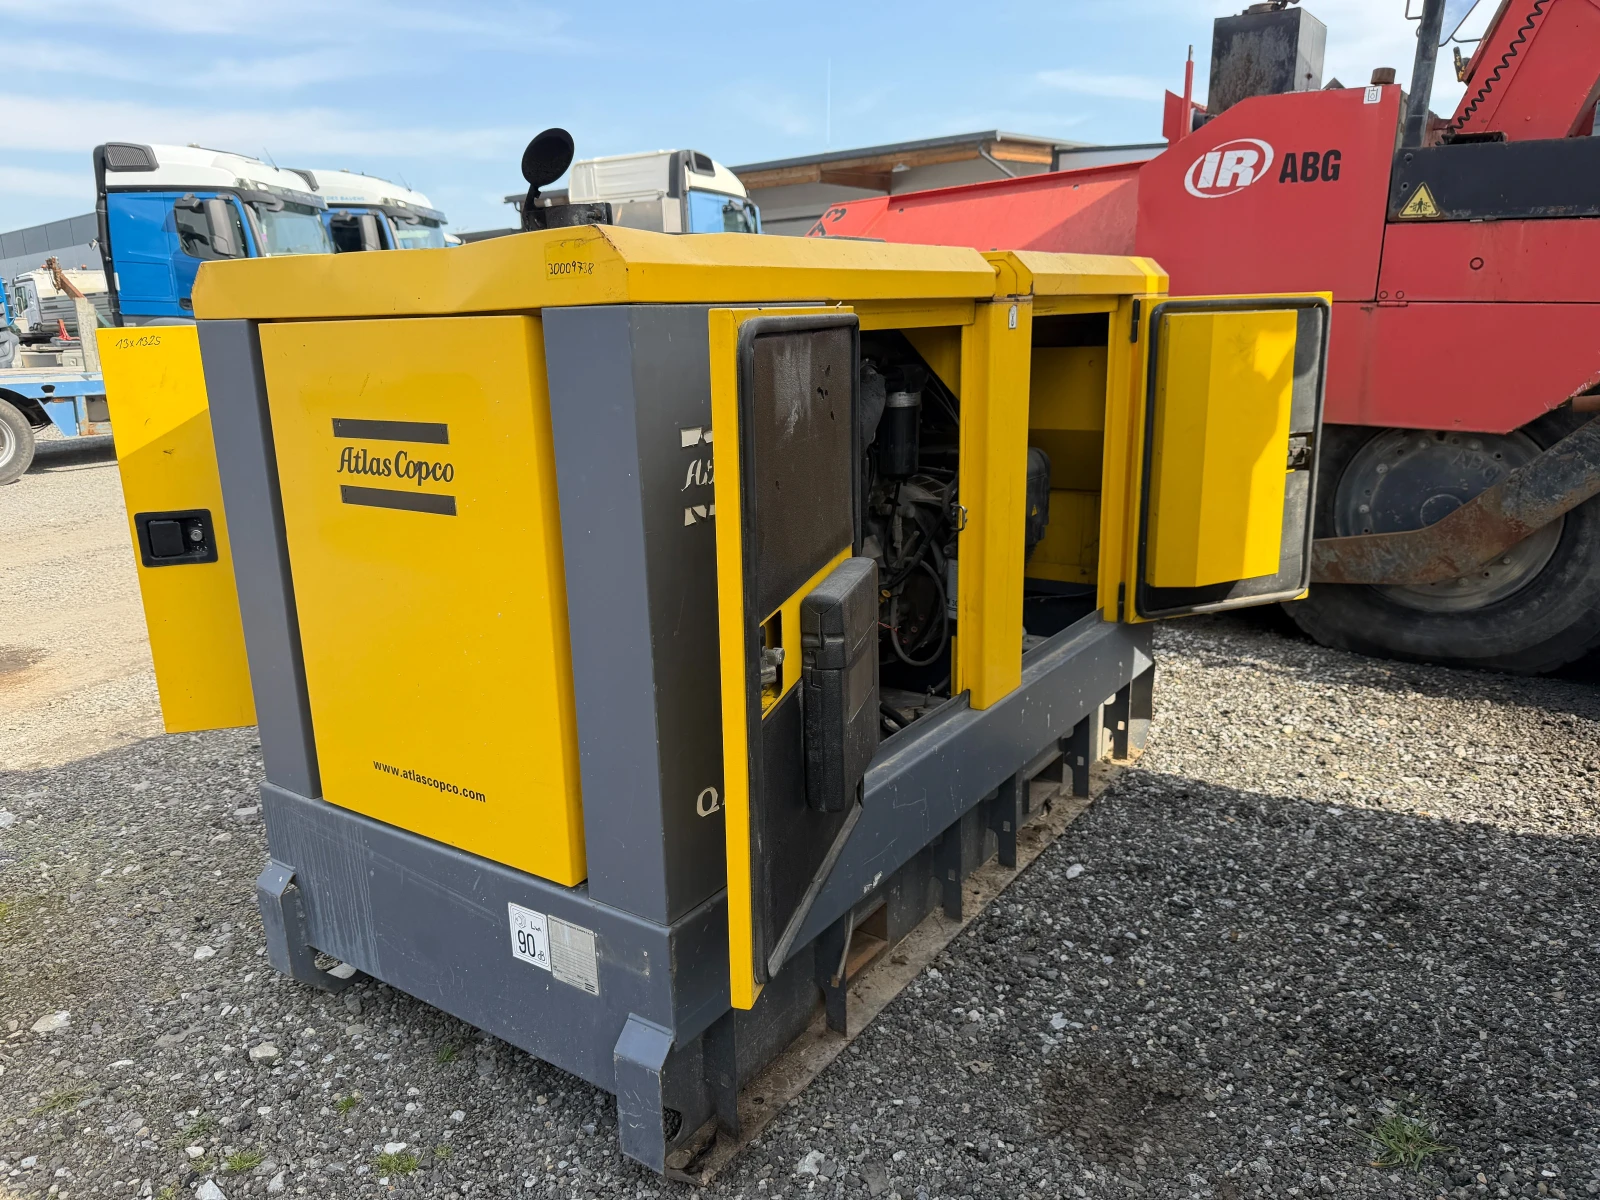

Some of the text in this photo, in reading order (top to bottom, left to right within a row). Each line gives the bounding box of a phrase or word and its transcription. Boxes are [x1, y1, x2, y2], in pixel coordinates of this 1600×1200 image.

[1197, 149, 1342, 188] IR ABG
[337, 446, 455, 487] Atlas Copco
[373, 760, 486, 803] www.atlascopco.com
[517, 929, 536, 958] 90
